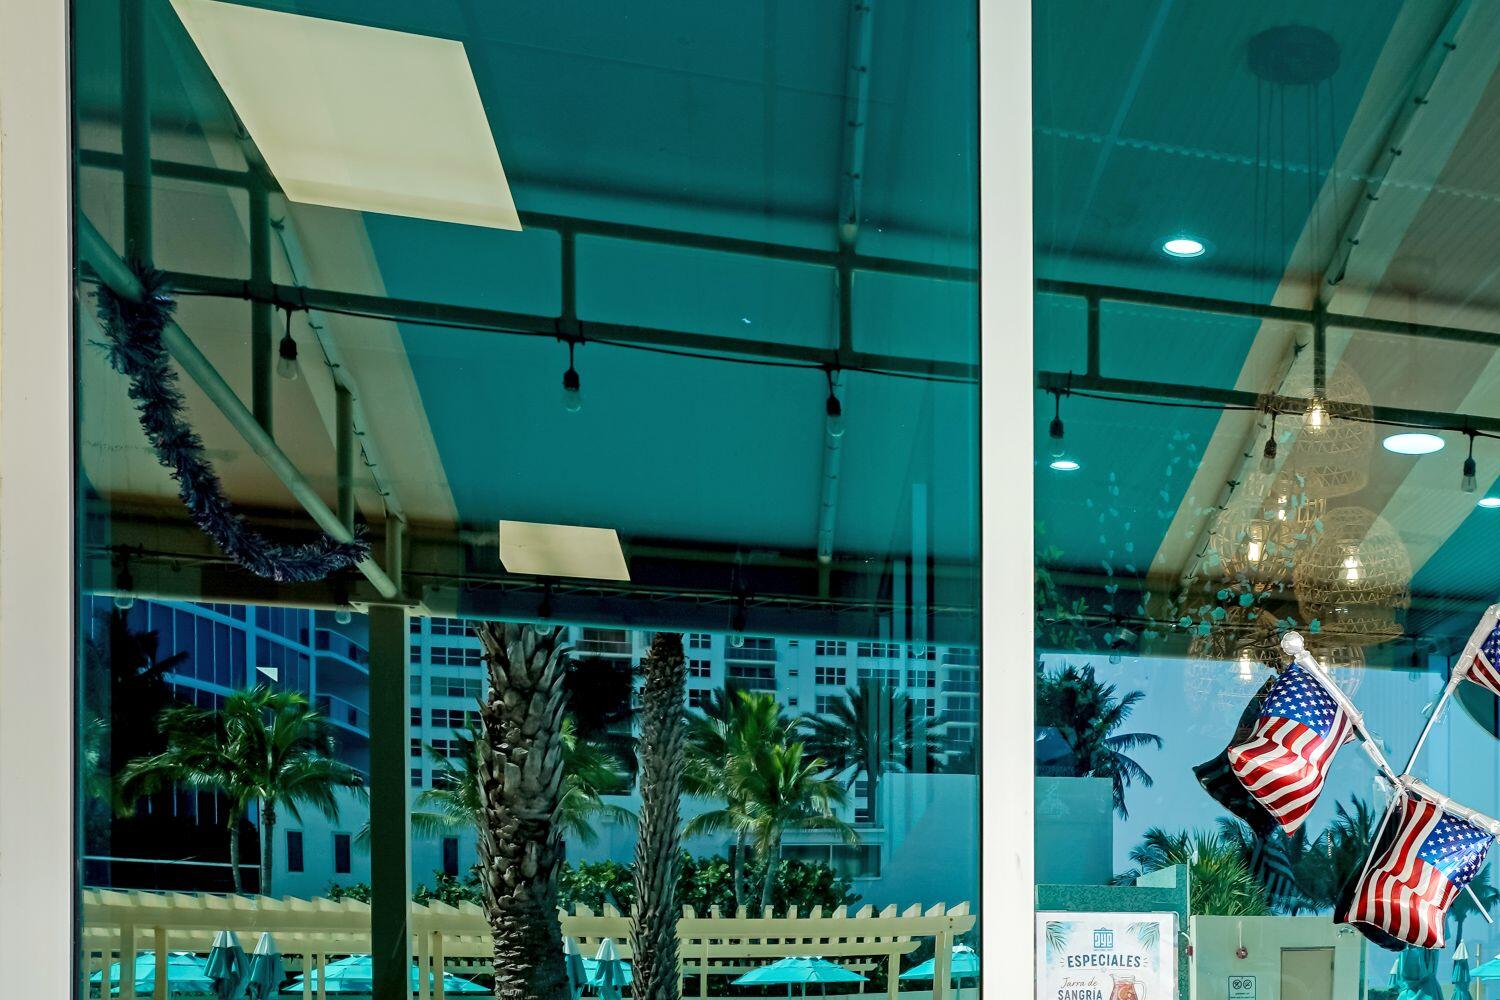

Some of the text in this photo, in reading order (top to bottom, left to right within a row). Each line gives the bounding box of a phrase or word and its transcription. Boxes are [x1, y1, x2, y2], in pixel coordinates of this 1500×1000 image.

[1067, 953, 1141, 968] ESPECIALES
[1060, 976, 1098, 989] Jarra de
[1057, 987, 1103, 1000] SANGRÍA
